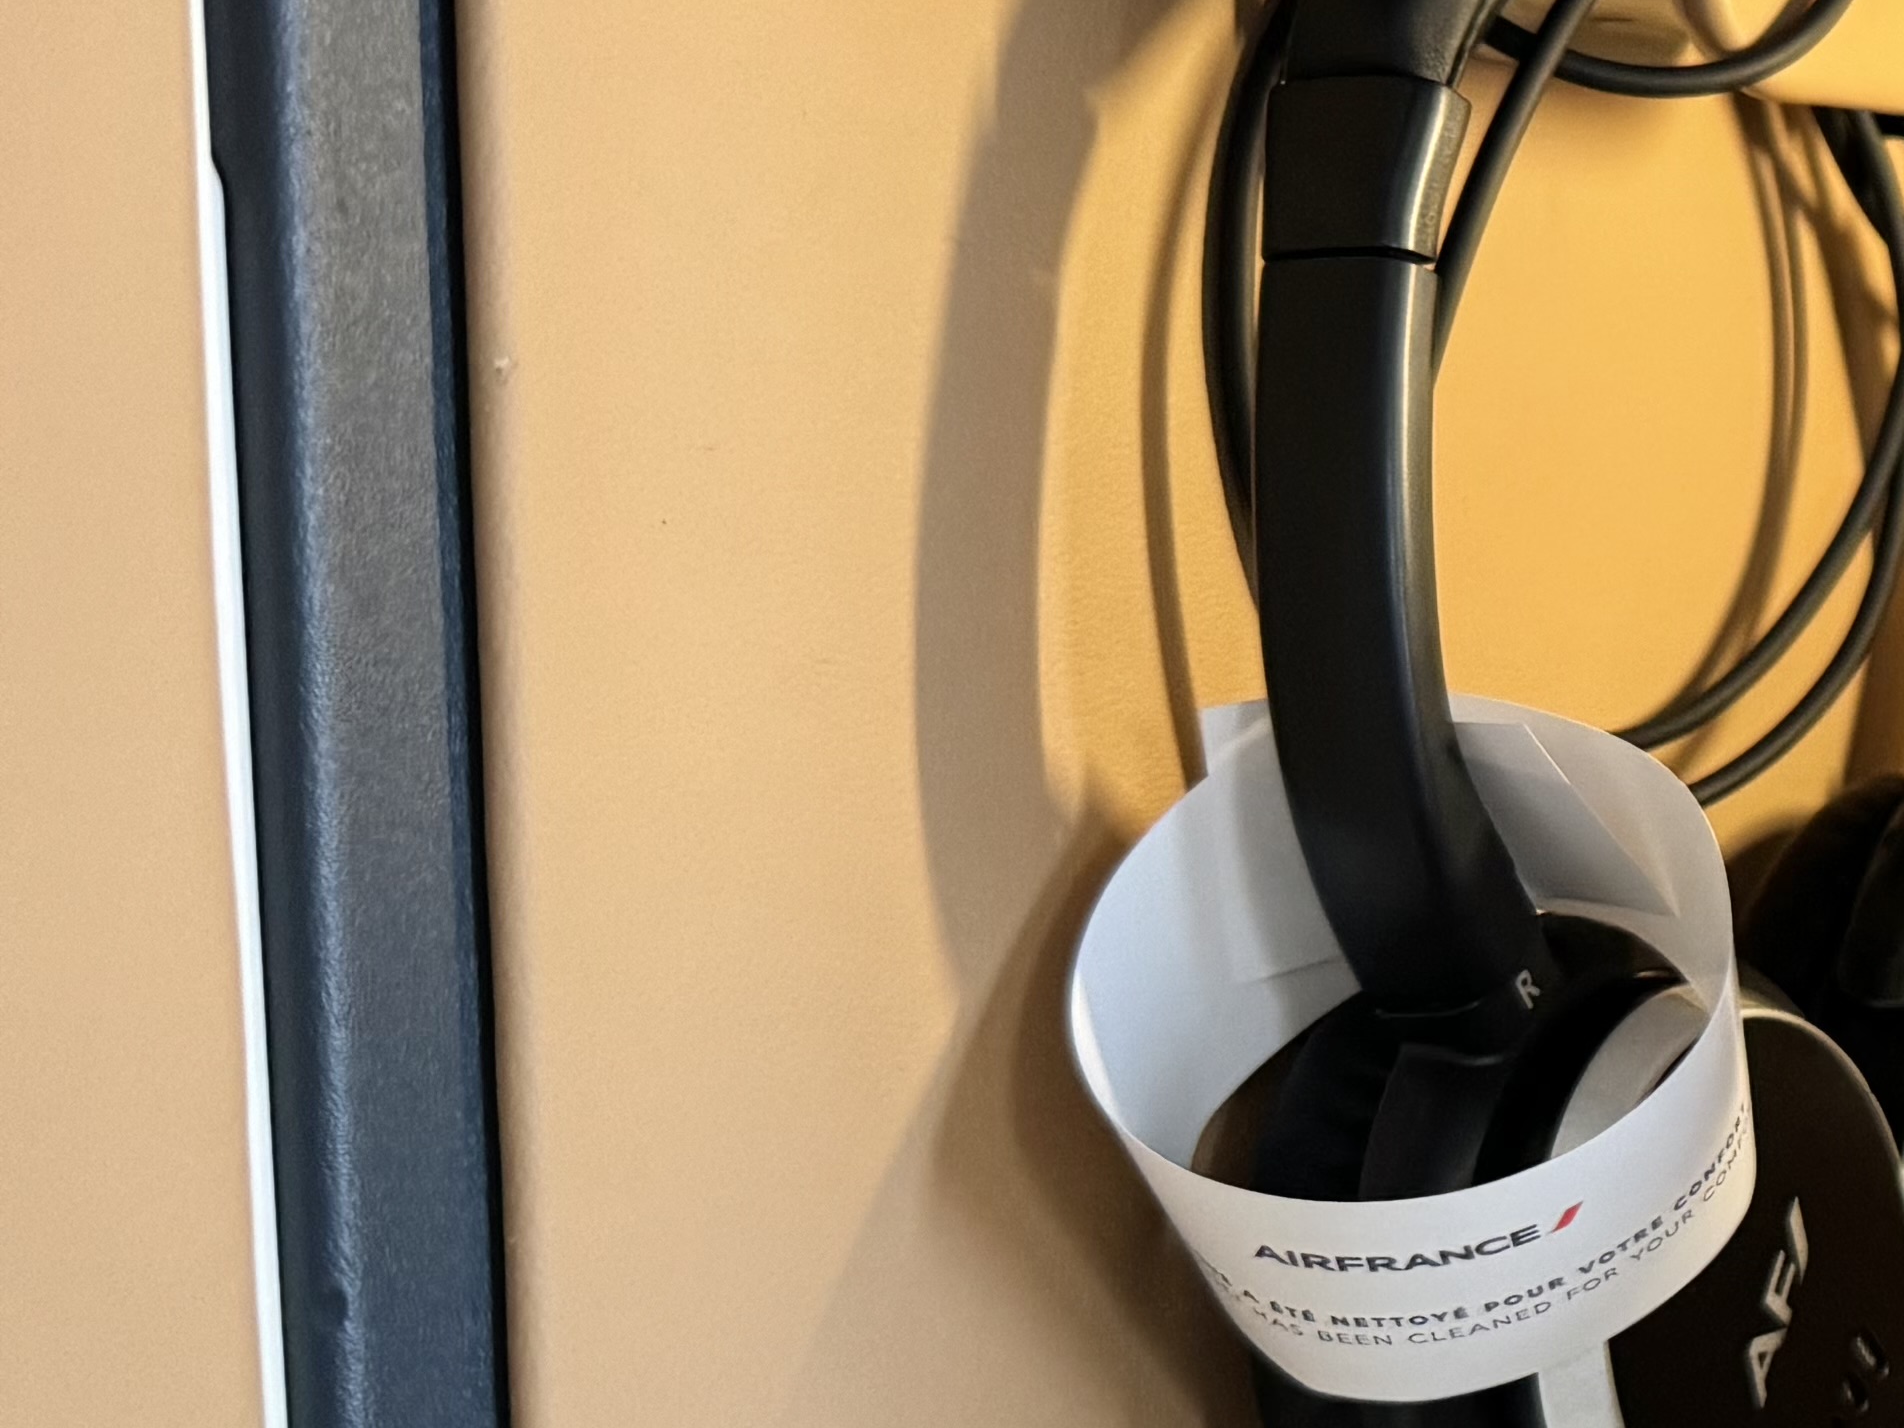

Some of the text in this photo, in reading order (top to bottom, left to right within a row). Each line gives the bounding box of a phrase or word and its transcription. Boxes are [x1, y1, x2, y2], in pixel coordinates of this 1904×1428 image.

[1515, 968, 1541, 1010] R
[1317, 1329, 1393, 1347] BEEN
[1407, 1301, 1552, 1345] CLEANED
[1566, 1267, 1619, 1301] FOR
[1631, 1209, 1694, 1262] YOUR
[1484, 1276, 1565, 1313] POUR
[1578, 1215, 1664, 1275] VOTRE
